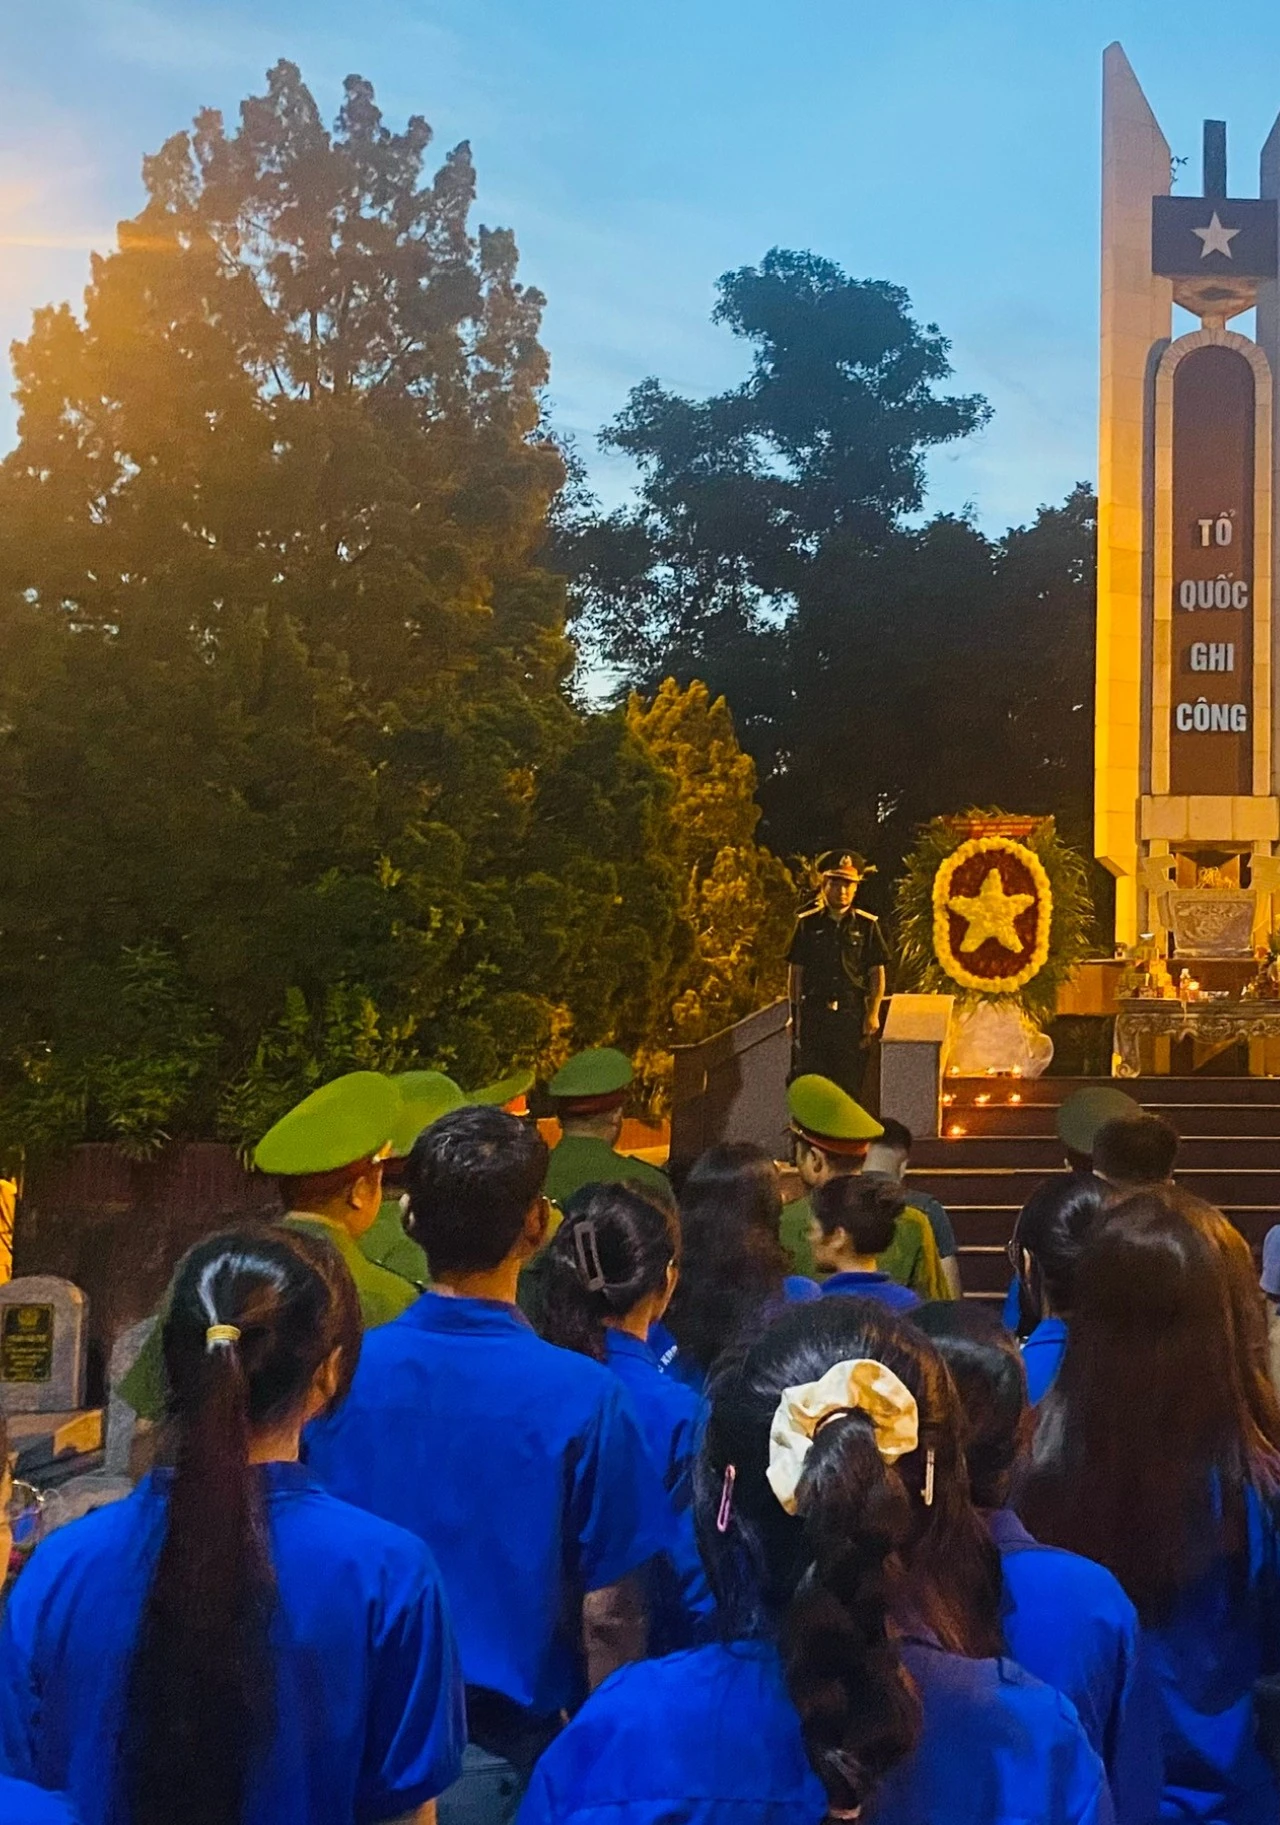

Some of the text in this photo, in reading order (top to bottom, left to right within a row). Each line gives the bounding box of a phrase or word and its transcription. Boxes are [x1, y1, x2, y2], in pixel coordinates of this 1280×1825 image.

[1198, 510, 1236, 546] TỔ
[1180, 574, 1247, 610] QUỐC
[1190, 642, 1234, 672] GHI
[1176, 697, 1247, 732] CÔNG
